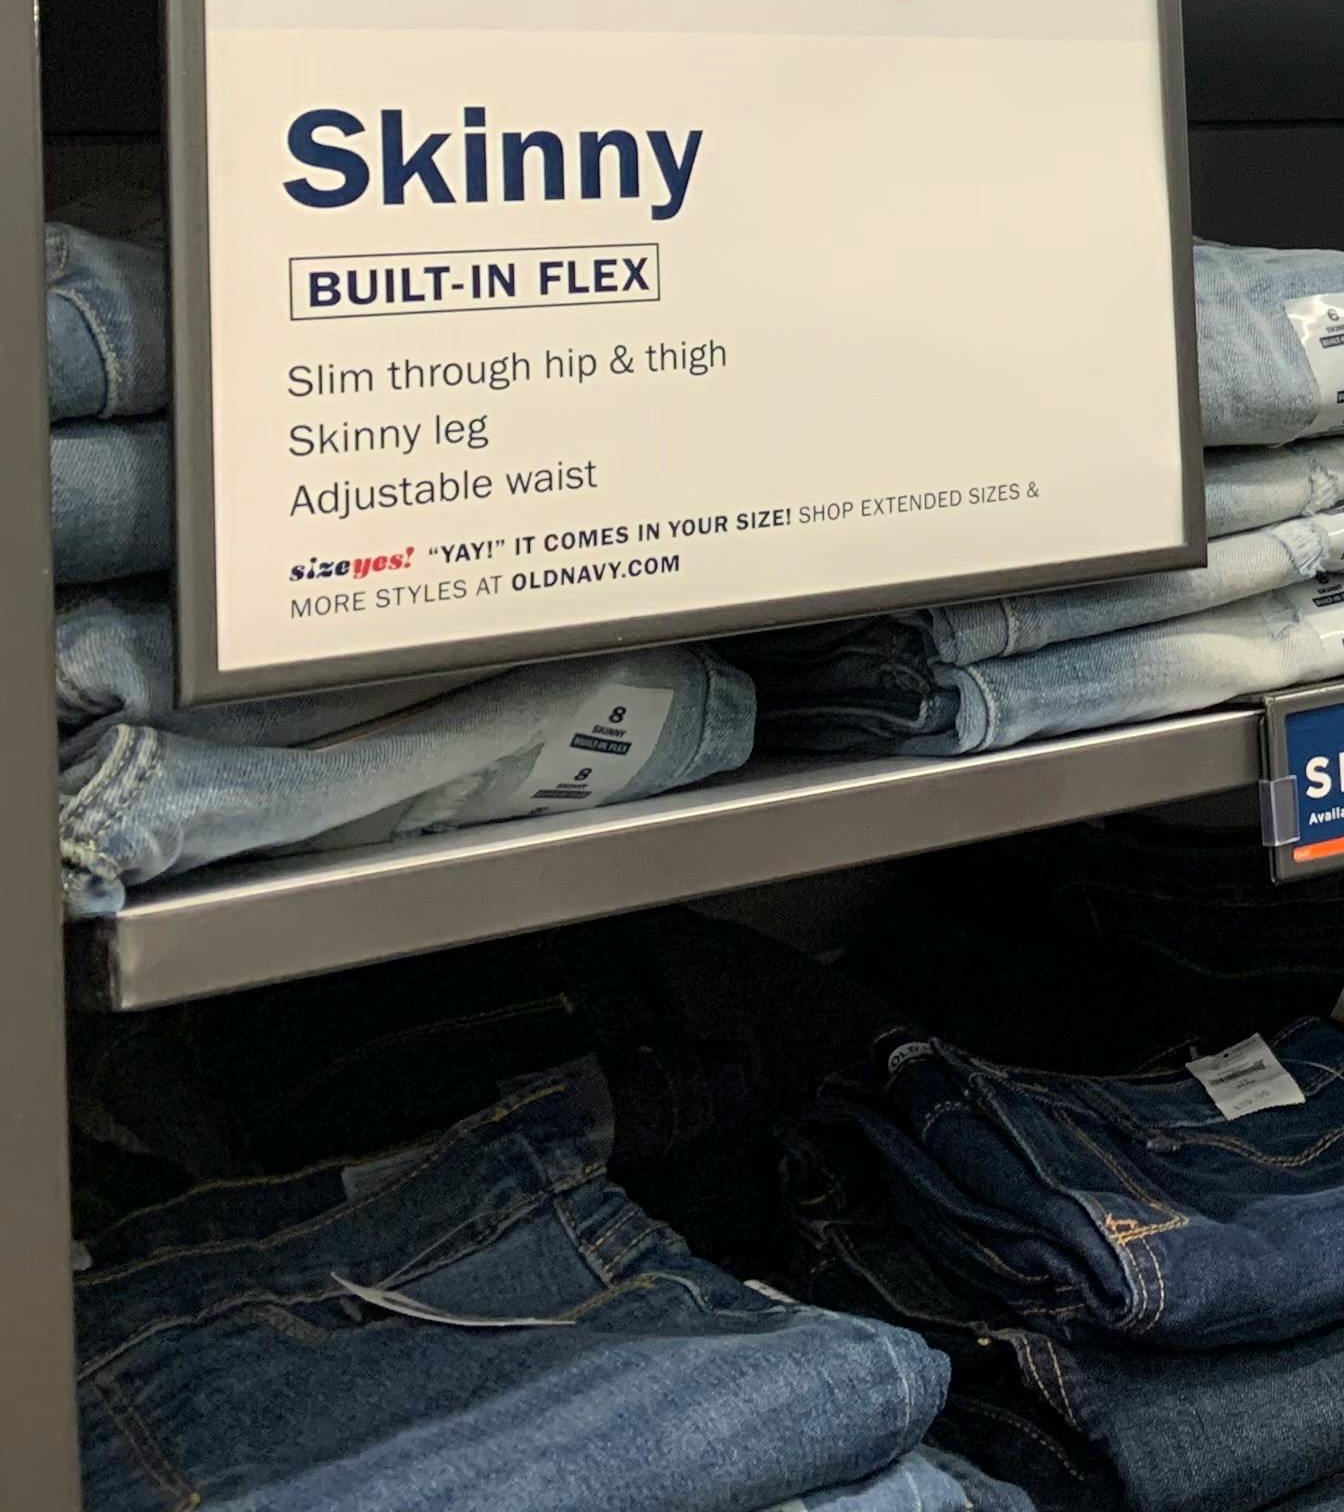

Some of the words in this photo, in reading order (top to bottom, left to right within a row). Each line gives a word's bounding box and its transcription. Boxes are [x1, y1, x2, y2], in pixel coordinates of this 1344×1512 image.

[283, 106, 702, 220] Skinny
[308, 264, 518, 309] BUILT-IN
[539, 258, 649, 298] FLEX
[1328, 309, 1339, 321] 6
[288, 364, 373, 397] Slim
[387, 352, 530, 390] through
[545, 349, 597, 384] hip
[609, 345, 635, 374] &
[645, 340, 726, 376] thigh
[288, 422, 421, 456] Skinny
[435, 415, 489, 449] leg
[290, 470, 493, 519] Adjustable
[506, 460, 598, 495] waist
[515, 537, 536, 555] IT
[544, 525, 629, 553] COMES
[638, 522, 660, 542] IN
[669, 516, 728, 538] YOUR
[736, 508, 792, 531] SIZE!
[799, 501, 854, 524] SHOP
[861, 489, 962, 517] EXTENDED
[969, 483, 1020, 505] SIZES
[1026, 481, 1040, 498] &
[291, 591, 366, 619] MORE
[376, 580, 467, 609] STYLES
[476, 575, 503, 597] AT
[511, 555, 680, 592] OLDNAVY.COM
[592, 725, 627, 738] SKINNY
[608, 706, 627, 723] 8
[609, 742, 630, 754] FLEX
[574, 768, 592, 781] 8
